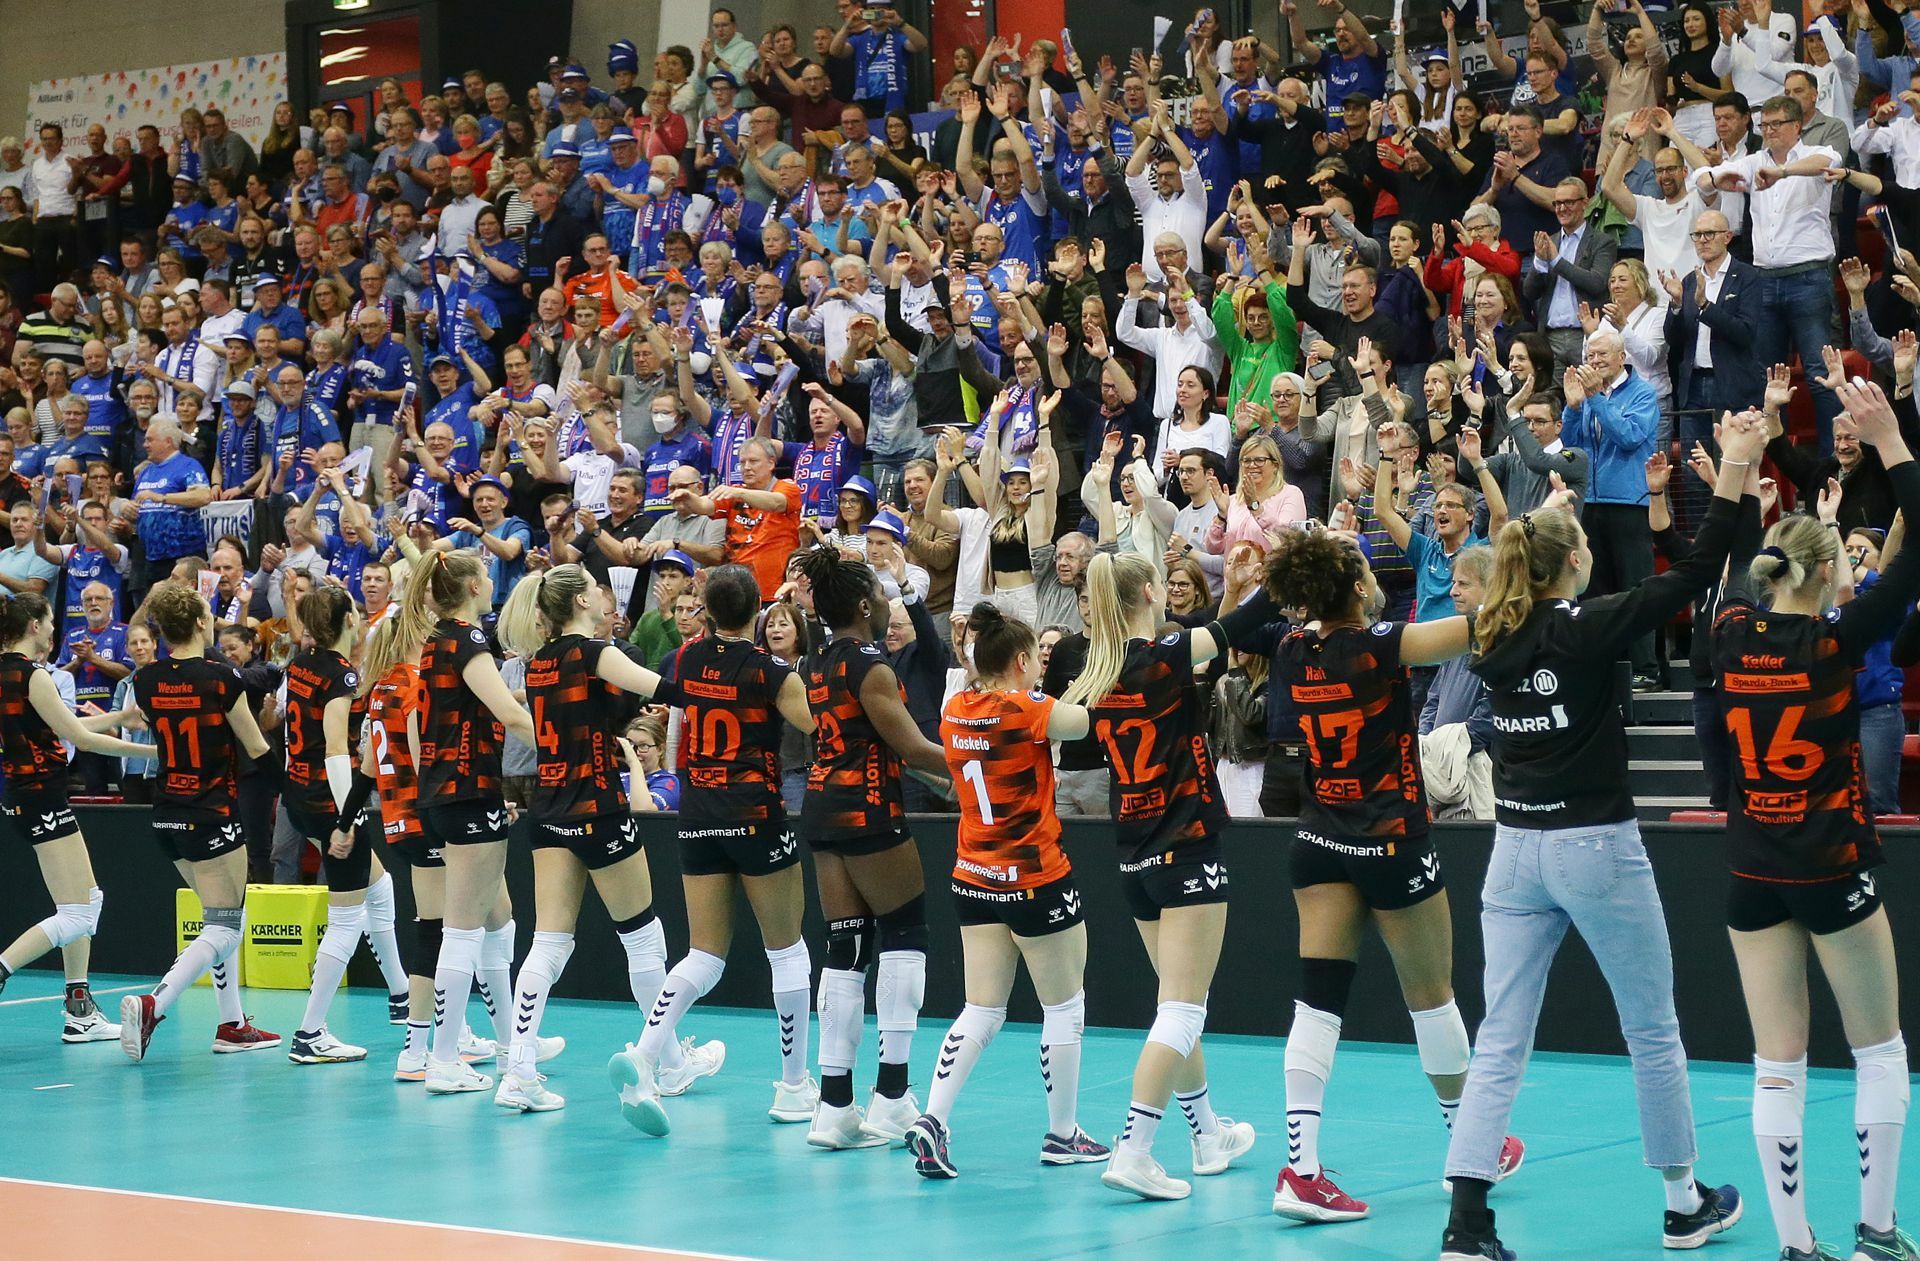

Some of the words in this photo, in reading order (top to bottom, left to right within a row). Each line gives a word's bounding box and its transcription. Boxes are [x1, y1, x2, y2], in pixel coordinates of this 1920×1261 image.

[71, 113, 89, 129] für
[702, 665, 721, 680] Lee
[1741, 654, 1787, 669] Keller
[1732, 676, 1799, 689] Sparda-Bank
[534, 695, 560, 756] 4
[685, 704, 741, 761] 10
[969, 716, 1001, 726] STUTTGART
[156, 716, 201, 769] 11
[459, 721, 471, 760] LOTTO
[592, 731, 604, 773] LOTTO
[952, 733, 990, 751] Koskelo
[1096, 718, 1169, 785] 12
[1298, 709, 1366, 769] 17
[1726, 705, 1825, 781] 16
[866, 742, 880, 789] LOTTO
[1191, 735, 1209, 779] OTTO
[962, 760, 995, 826] 1
[1504, 799, 1521, 811] MTV
[1521, 800, 1567, 812] Stuttgart
[59, 815, 77, 825] Allian
[678, 826, 747, 839] SCHARRmant
[1297, 830, 1384, 857] SCHARRmant
[251, 924, 302, 936] KÄRCHER
[843, 918, 865, 929] cep
